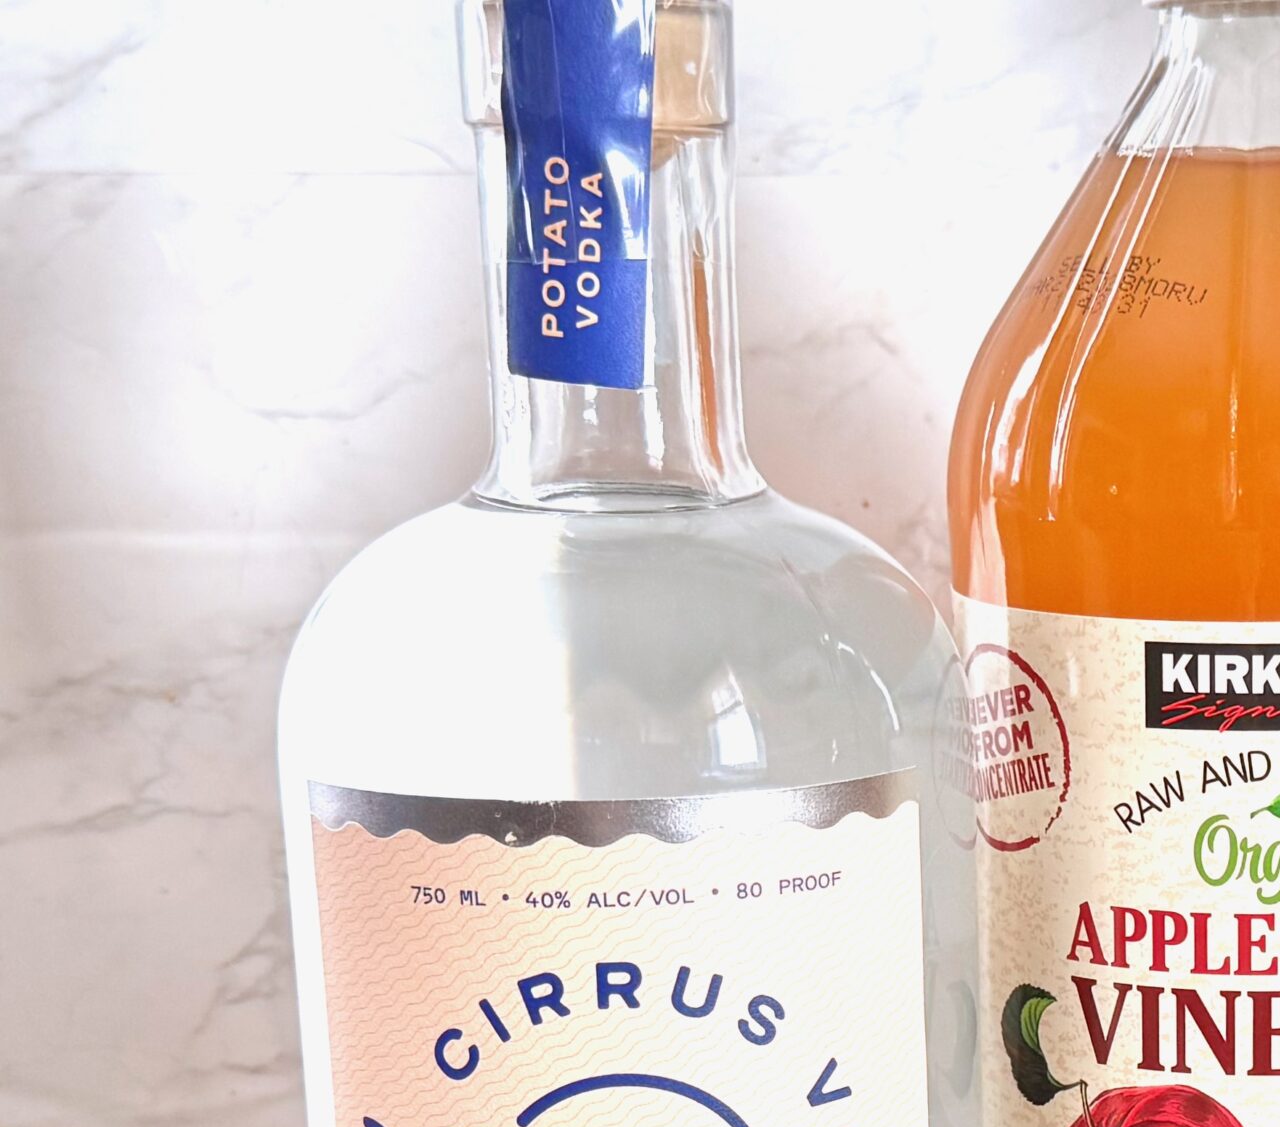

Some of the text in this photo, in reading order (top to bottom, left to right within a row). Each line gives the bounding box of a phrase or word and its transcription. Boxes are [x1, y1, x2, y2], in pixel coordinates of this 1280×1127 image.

[541, 156, 570, 339] POTATO
[576, 172, 603, 329] VODKA
[1126, 255, 1161, 275] BY
[973, 720, 1034, 762] FROM
[975, 752, 1056, 803] ONCENTRATE
[1113, 769, 1186, 835] RAW
[1200, 749, 1272, 794] AND
[410, 870, 843, 910] 750 ML 40% ALC/VOL 80 PROOF
[1066, 900, 1279, 977] APPLE
[433, 961, 785, 1081] CIRRUS
